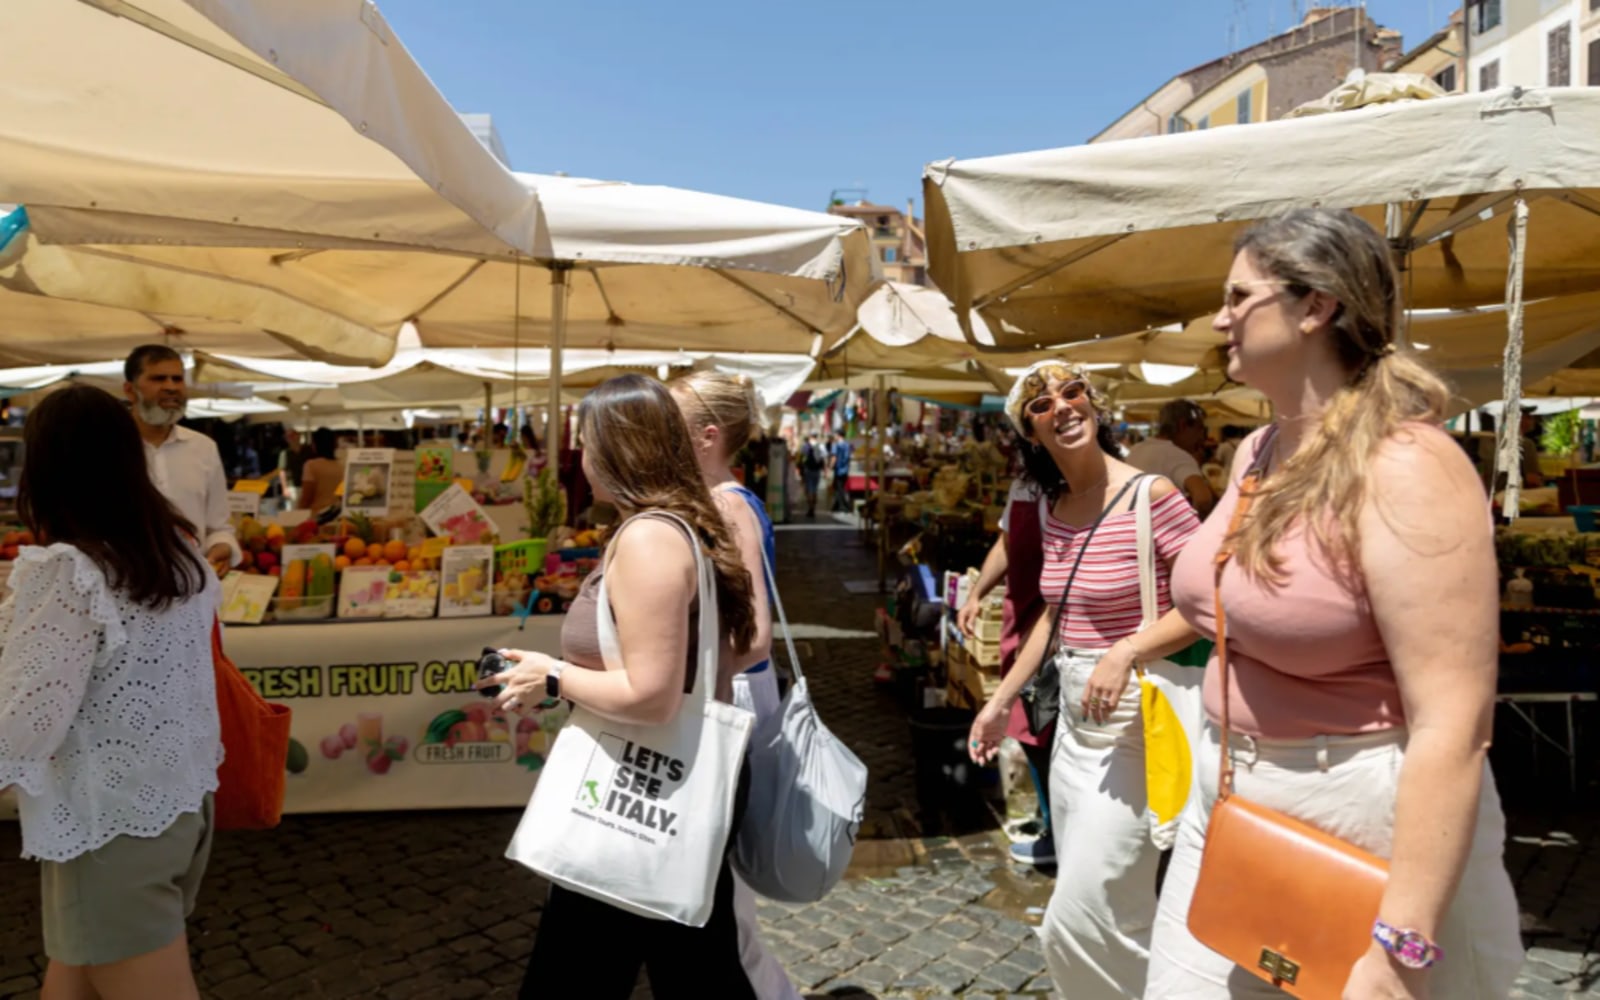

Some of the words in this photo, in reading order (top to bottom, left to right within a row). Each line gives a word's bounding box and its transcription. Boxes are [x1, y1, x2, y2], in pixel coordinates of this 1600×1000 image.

[240, 666, 321, 698] RESH
[329, 662, 417, 696] FRUIT
[426, 742, 464, 761] FRESH
[468, 743, 502, 761] FRUIT
[622, 741, 684, 782] LET'S
[614, 766, 662, 801] SEE
[605, 790, 677, 836] ITALY.
